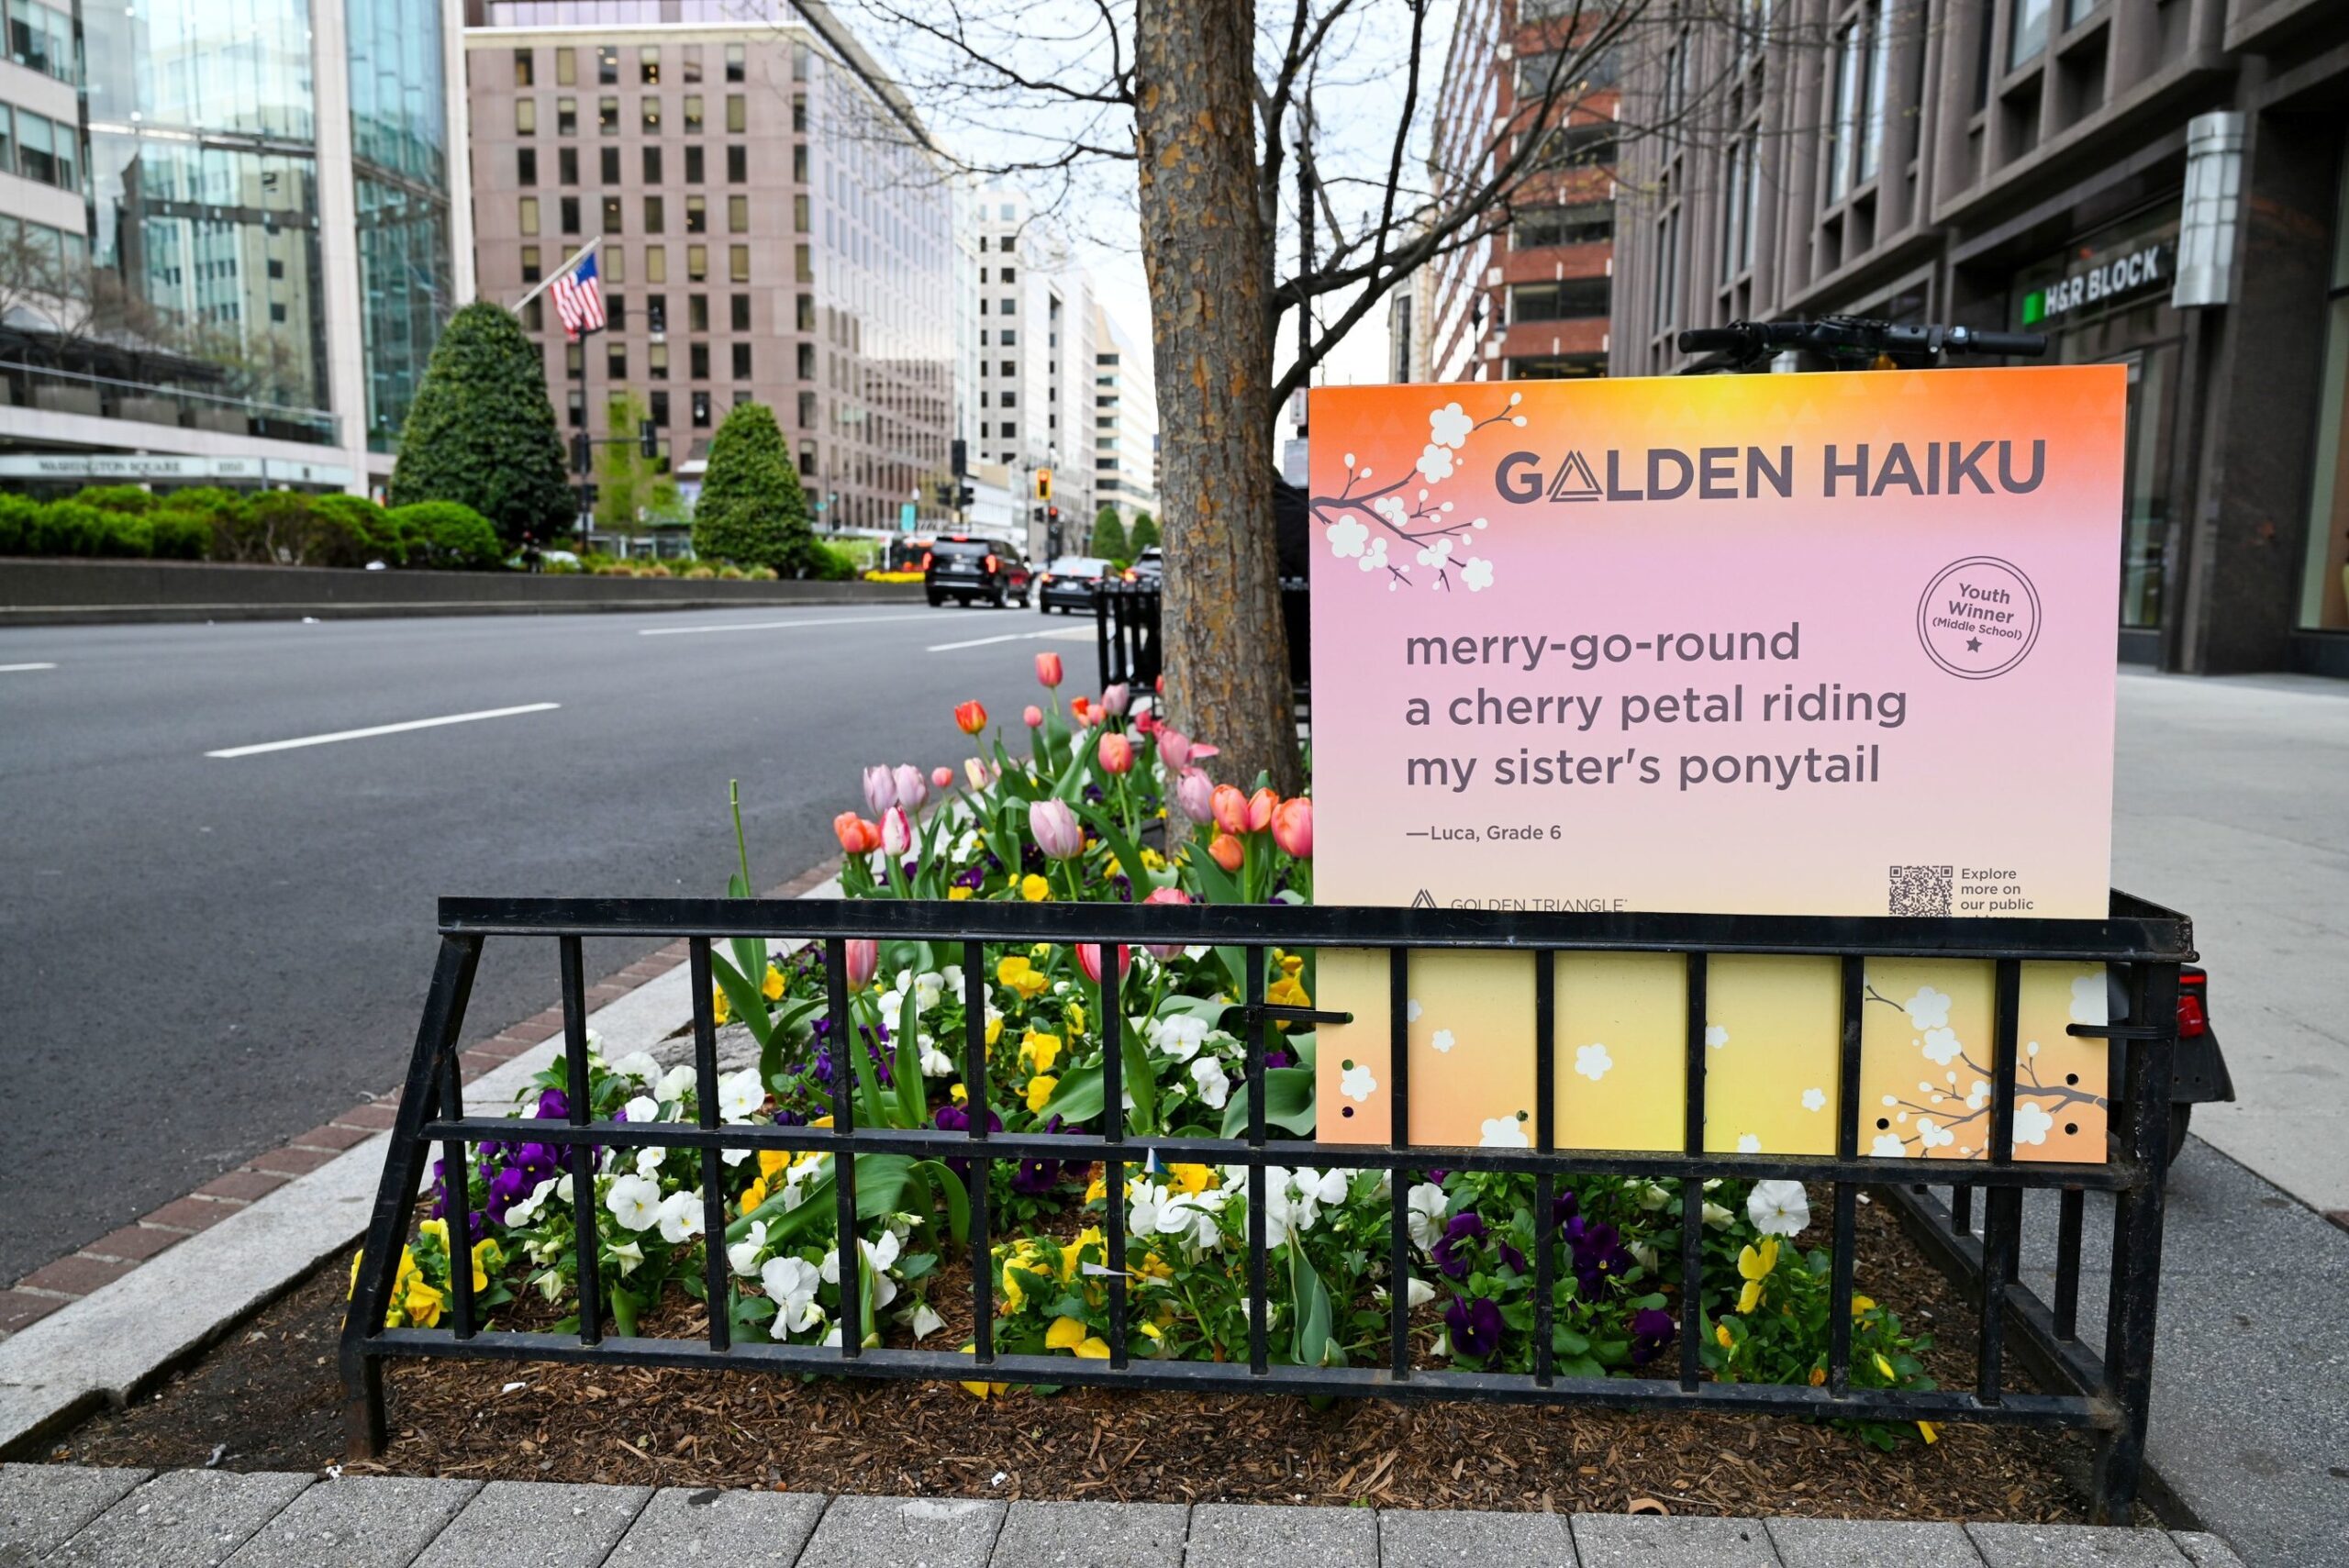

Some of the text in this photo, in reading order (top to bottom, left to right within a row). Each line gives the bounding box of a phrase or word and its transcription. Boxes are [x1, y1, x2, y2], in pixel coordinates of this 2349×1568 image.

[2087, 245, 2159, 301] BLOCK
[130, 462, 181, 473] SQUARE
[1824, 439, 2046, 497] HAIKU
[1959, 583, 2010, 605] Youth
[1949, 600, 2014, 624] Winner
[1932, 617, 2022, 640] (Middle School)
[1407, 621, 1799, 672] merry-go-round
[1406, 683, 1908, 732] a cherry petal riding
[1407, 744, 1881, 794] my sister's ponytail
[1486, 824, 1544, 840] Grade
[1550, 824, 1562, 840] 6
[1961, 867, 2018, 882] Explore
[1961, 885, 2021, 895] more on
[1451, 898, 1624, 913] GOLDEN TRIANGLE
[1960, 898, 2034, 912] our public
